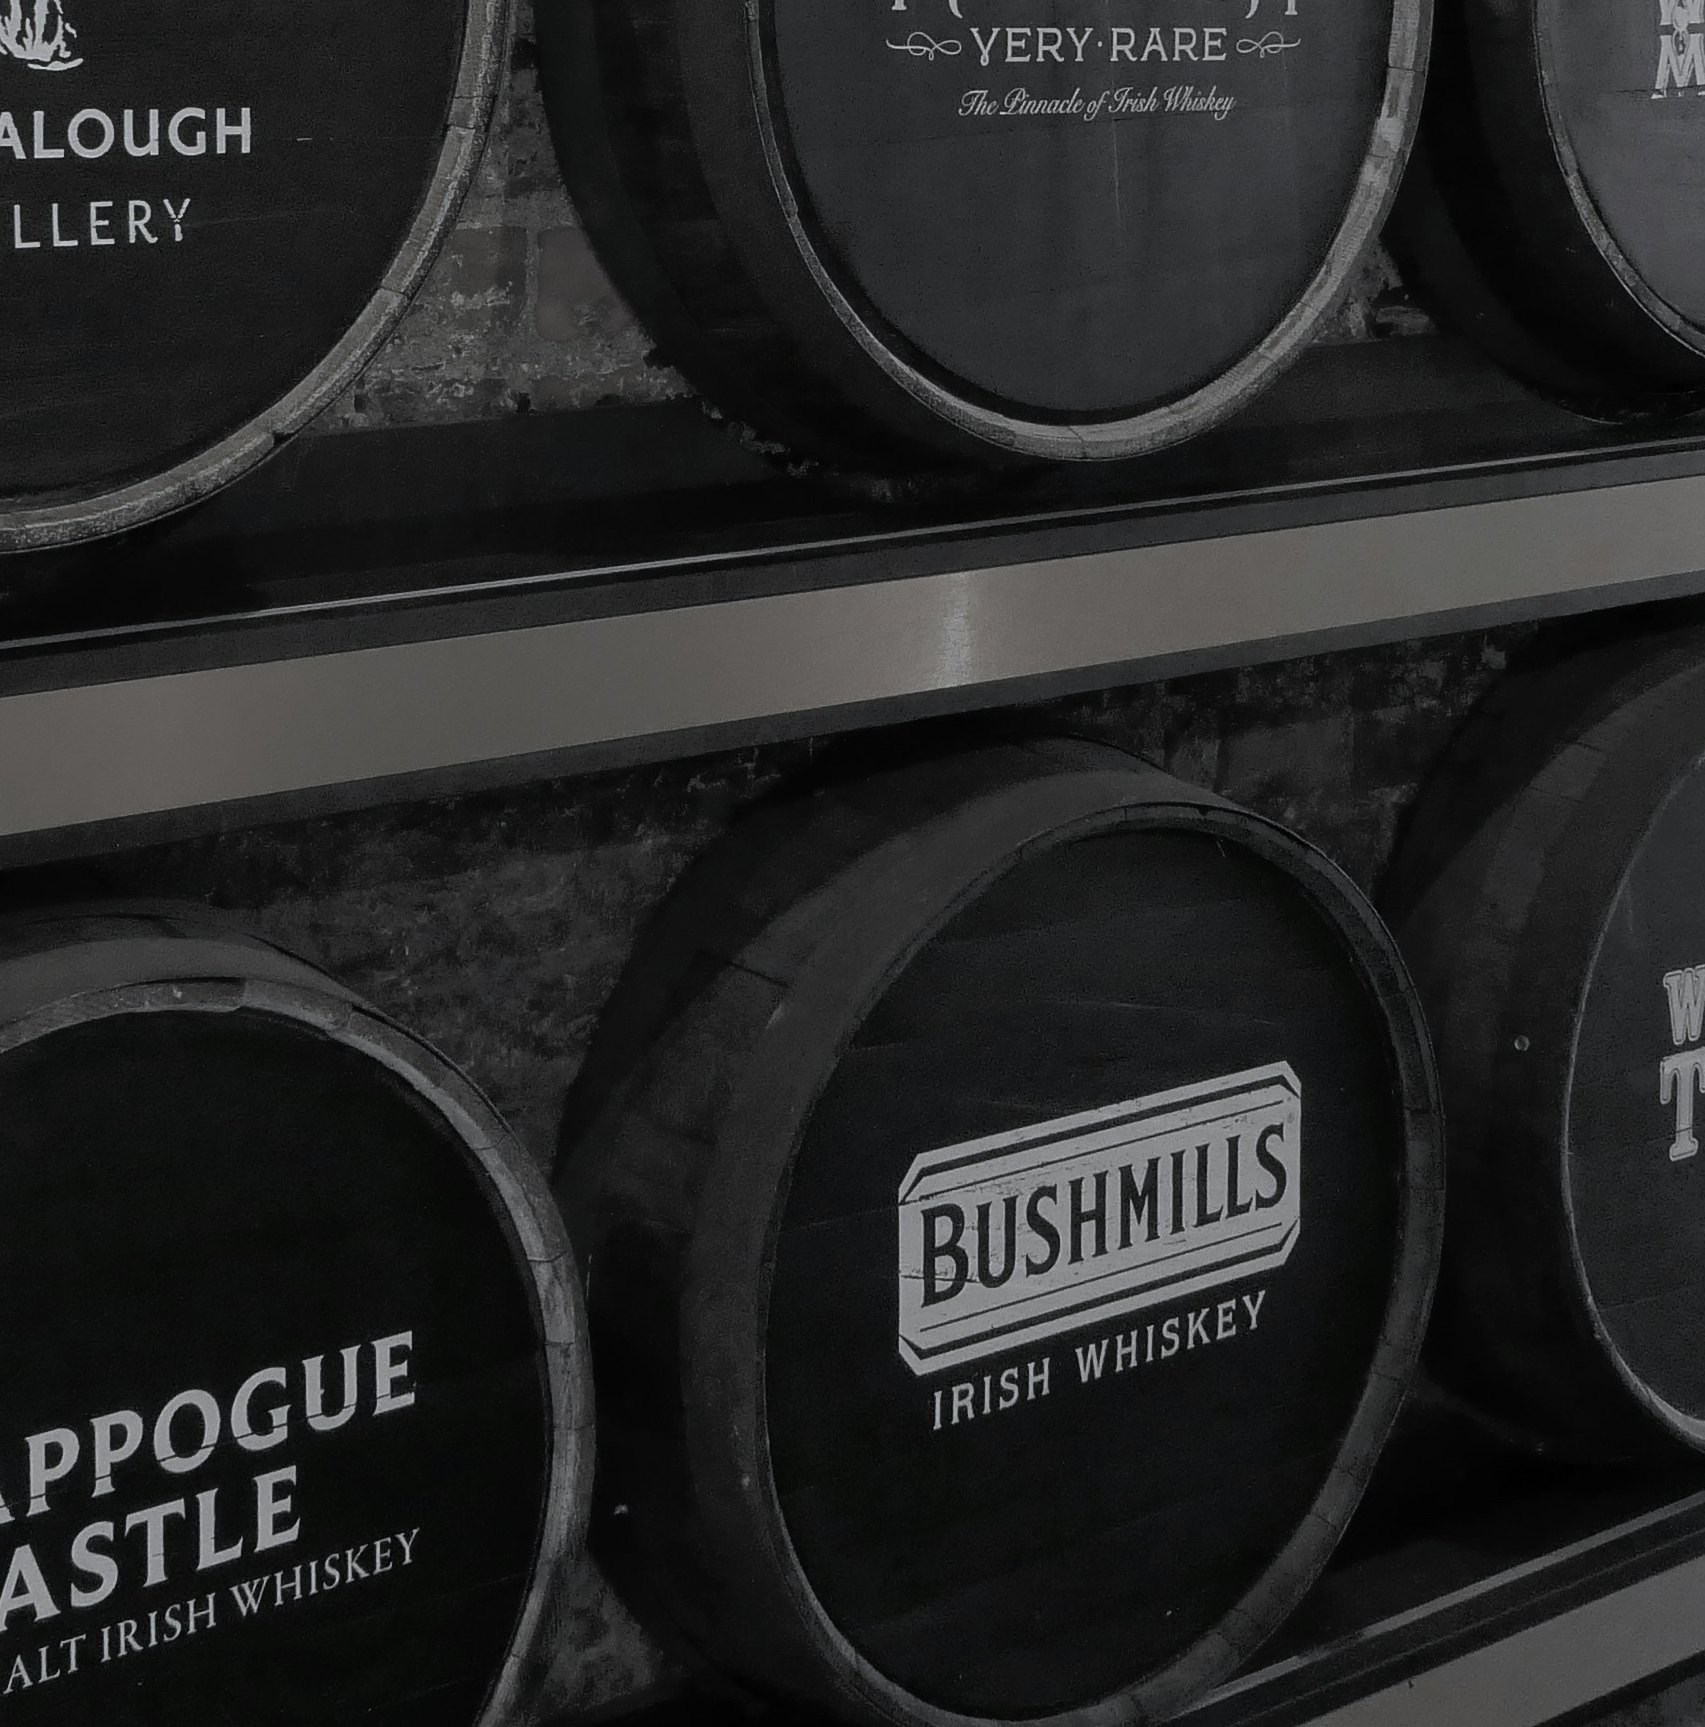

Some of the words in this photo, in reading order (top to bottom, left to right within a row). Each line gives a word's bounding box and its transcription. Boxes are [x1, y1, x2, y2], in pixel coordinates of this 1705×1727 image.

[959, 89, 999, 116] The
[998, 87, 1084, 116] Pinnacle
[1083, 89, 1110, 121] of
[1108, 87, 1159, 114] Irish
[1163, 86, 1236, 120] Whiskey
[921, 1123, 1287, 1308] BUSHMILLS
[933, 1358, 1051, 1431] IRISH
[1075, 1290, 1266, 1384] WHISKEY
[100, 1593, 217, 1663] IRISH
[231, 1528, 421, 1619] WHISKEY
